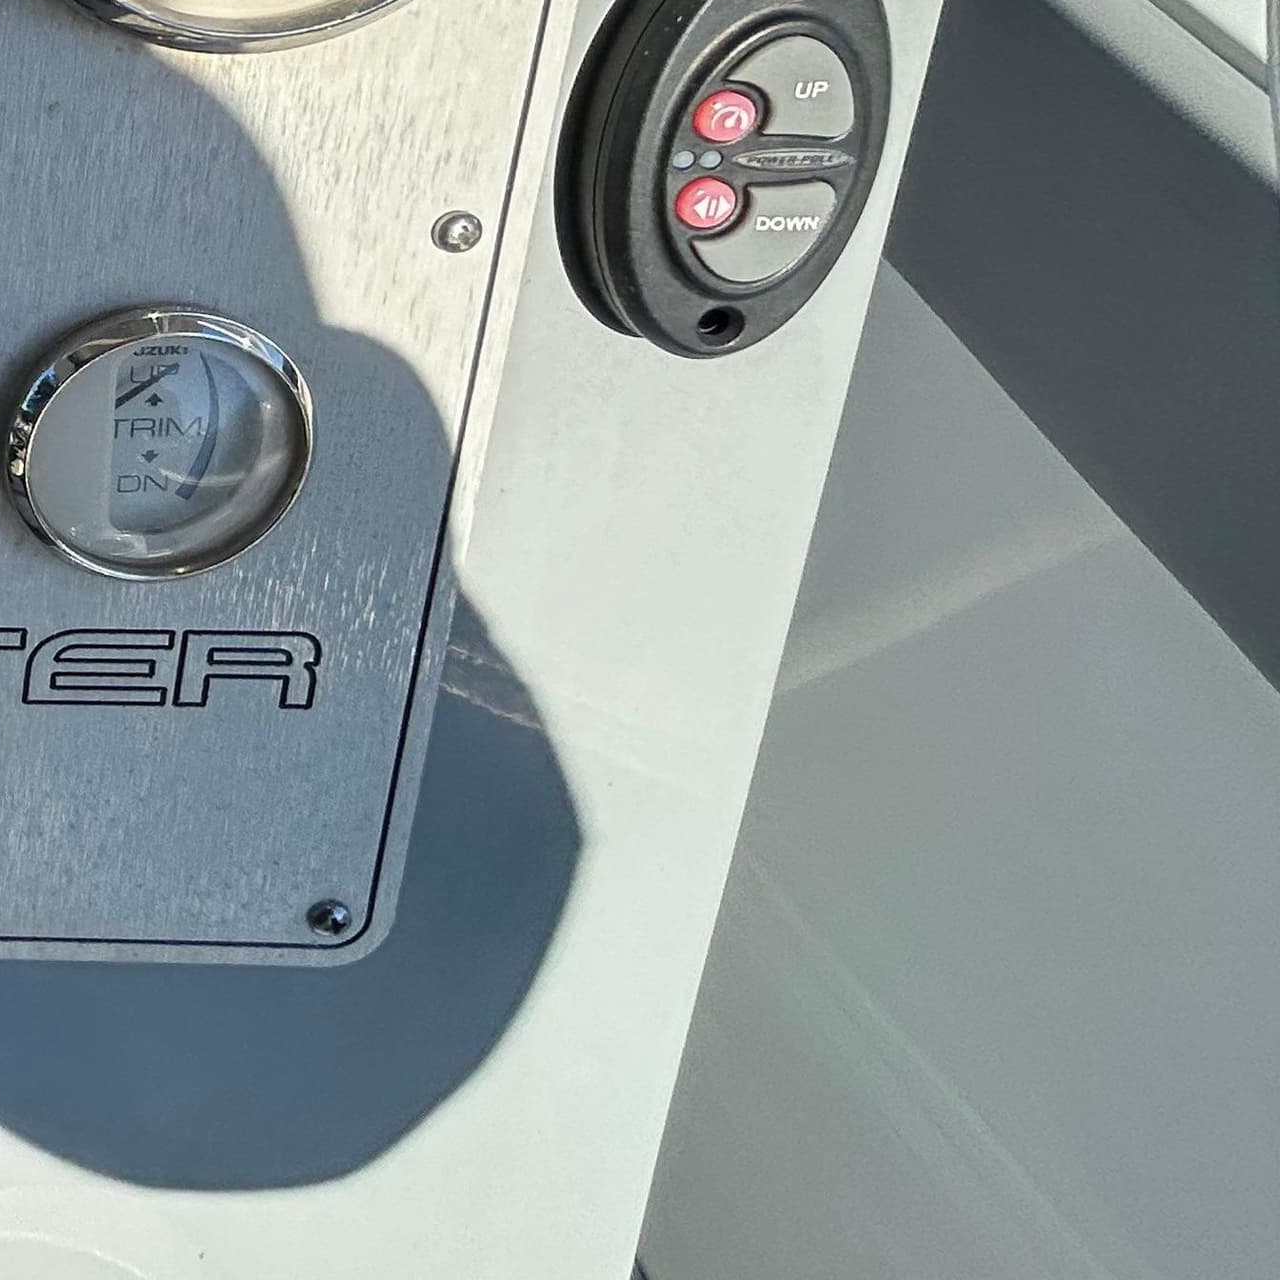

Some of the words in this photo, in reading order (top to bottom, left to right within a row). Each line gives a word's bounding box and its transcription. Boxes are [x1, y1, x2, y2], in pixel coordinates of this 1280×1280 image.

[795, 81, 830, 99] UP
[755, 215, 820, 233] DOWN
[130, 362, 181, 383] UP
[113, 416, 203, 440] TRIM
[117, 474, 169, 494] DN
